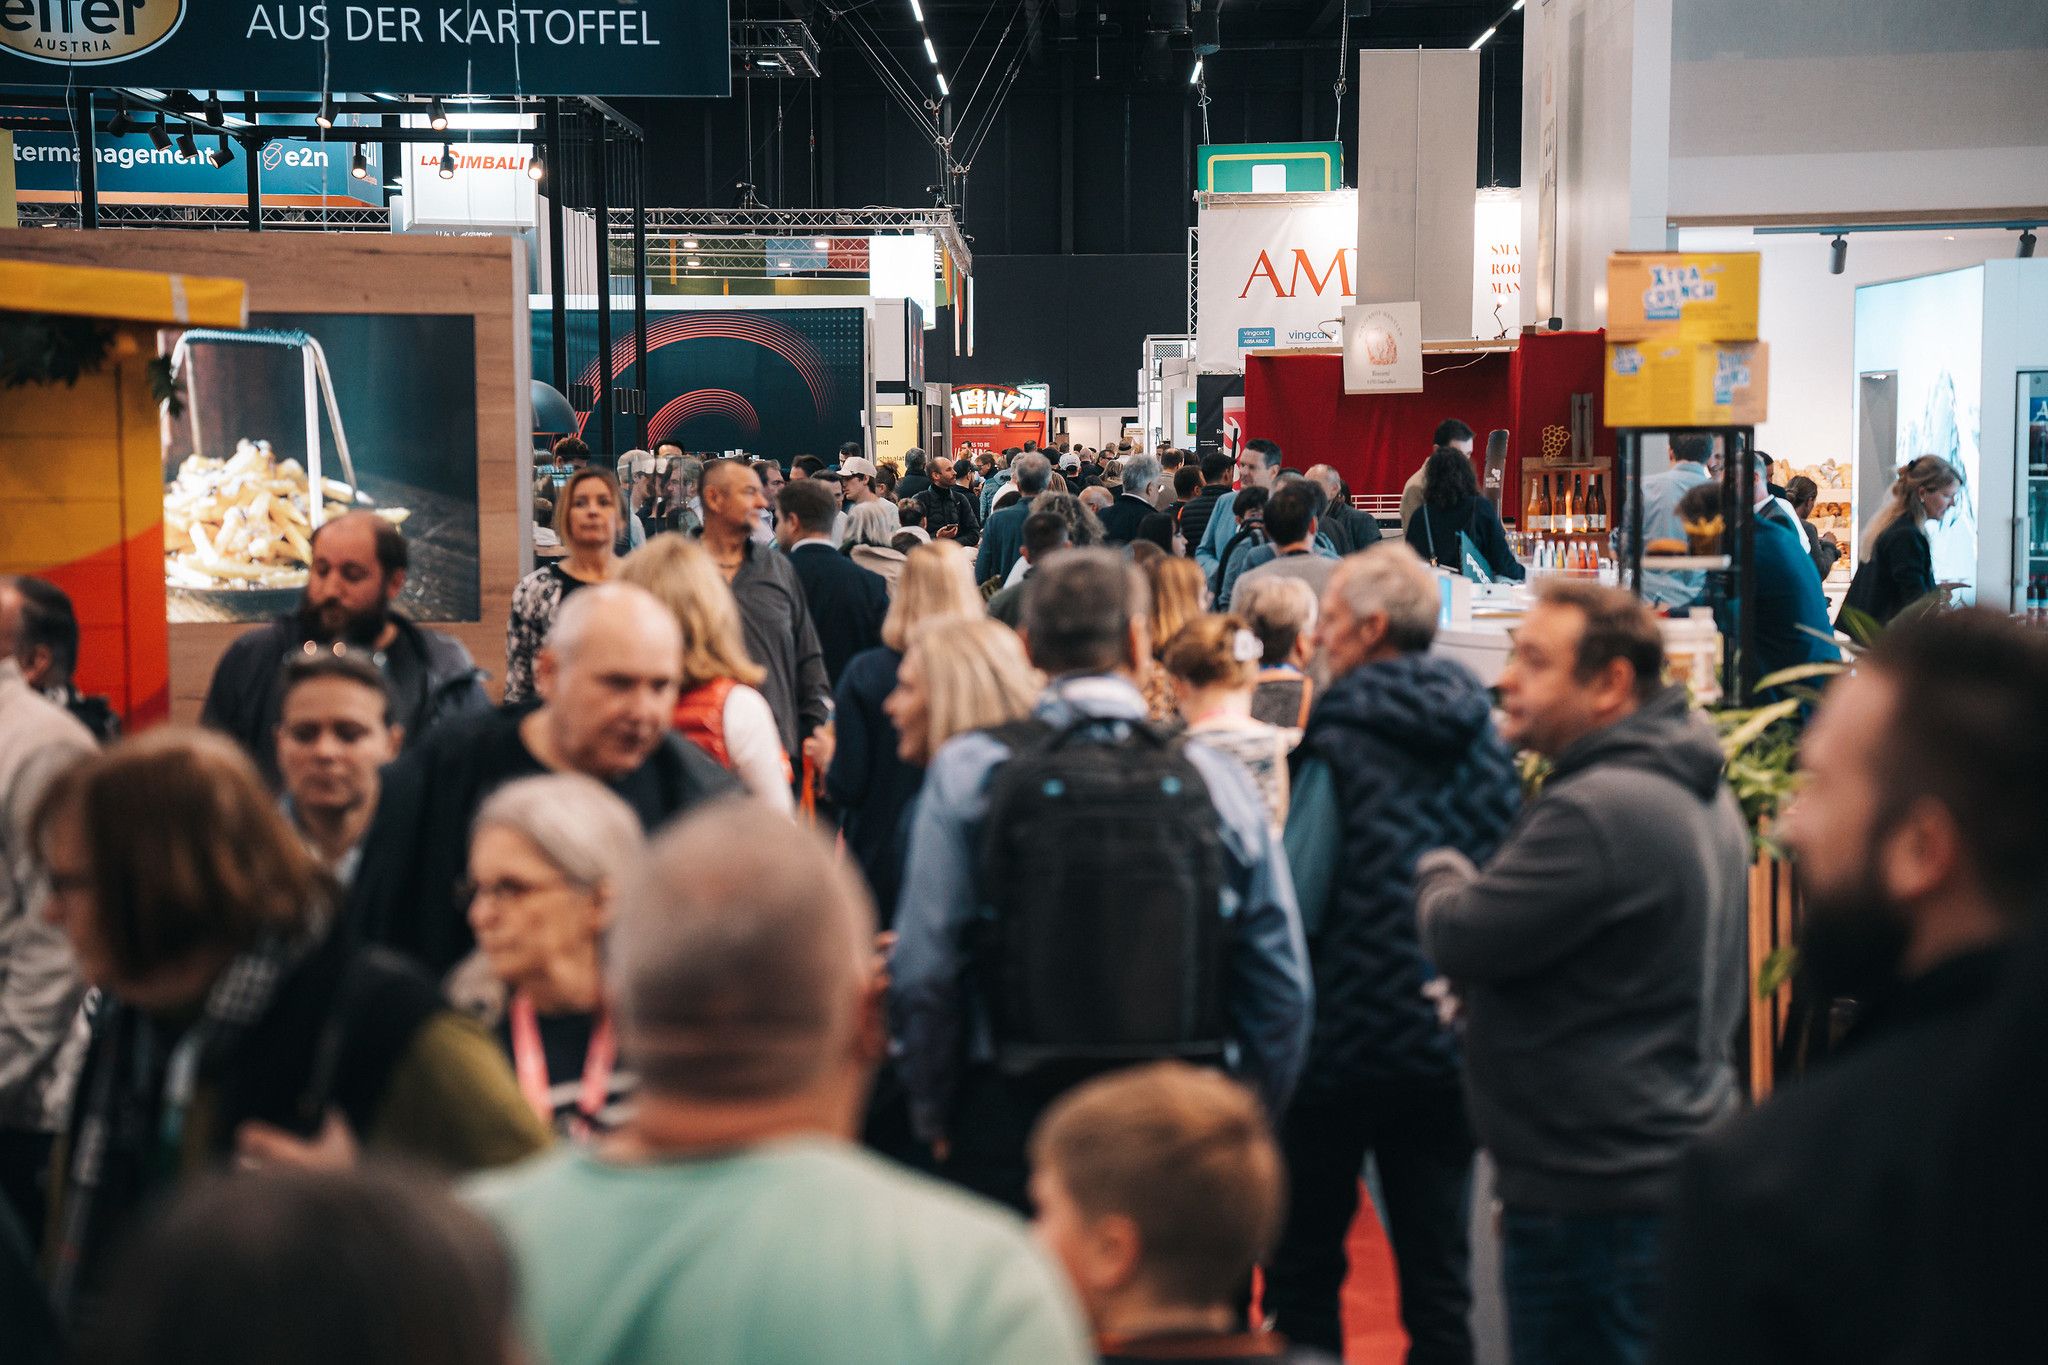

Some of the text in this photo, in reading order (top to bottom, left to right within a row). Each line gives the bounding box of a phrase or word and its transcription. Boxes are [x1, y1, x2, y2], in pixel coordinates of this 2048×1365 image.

[246, 4, 661, 46] AUS DER KARTOFFEL
[34, 37, 111, 53] AUSTRIA
[284, 147, 329, 167] e2n
[421, 155, 439, 166] LA
[1238, 248, 1359, 298] AM
[1243, 329, 1270, 337] vingcard
